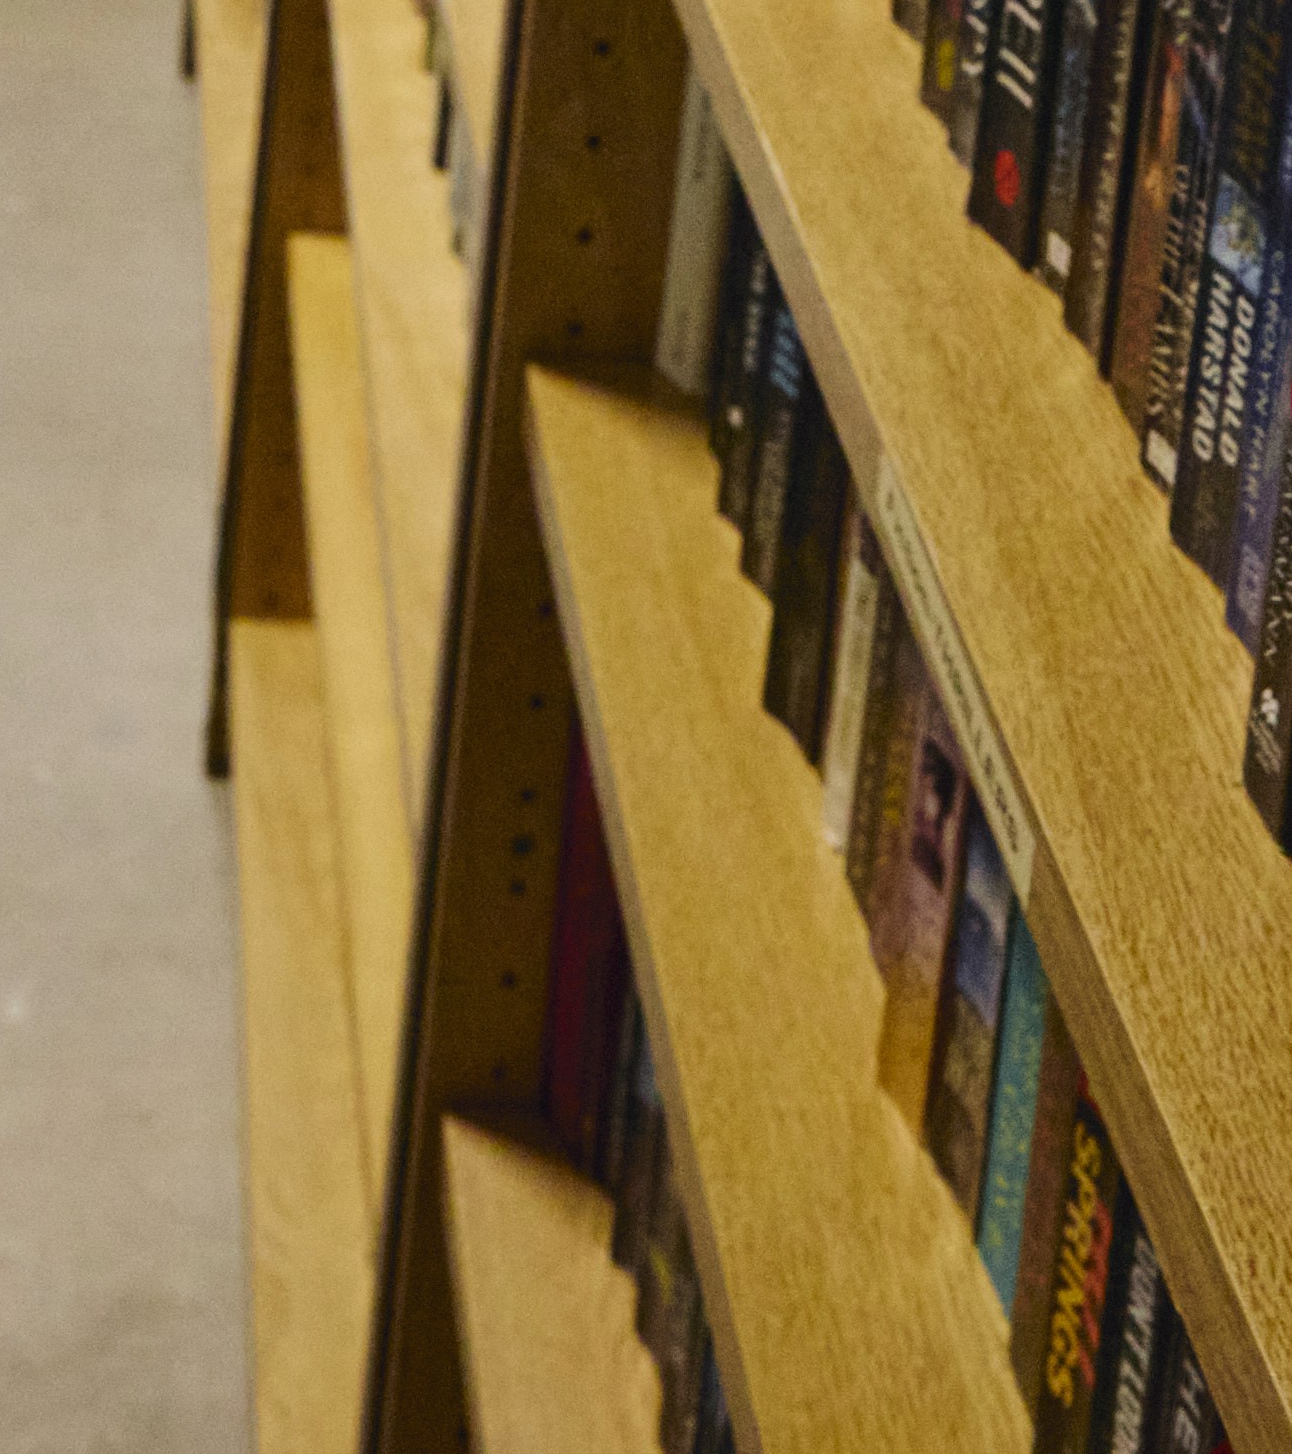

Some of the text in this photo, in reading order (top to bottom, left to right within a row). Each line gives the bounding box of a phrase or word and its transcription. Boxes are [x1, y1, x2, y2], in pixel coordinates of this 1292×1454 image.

[1190, 267, 1234, 465] HARSTAD
[1216, 292, 1257, 471] DONALD
[1253, 246, 1288, 417] CAROLYN
[1045, 1123, 1103, 1408] SPRINGS
